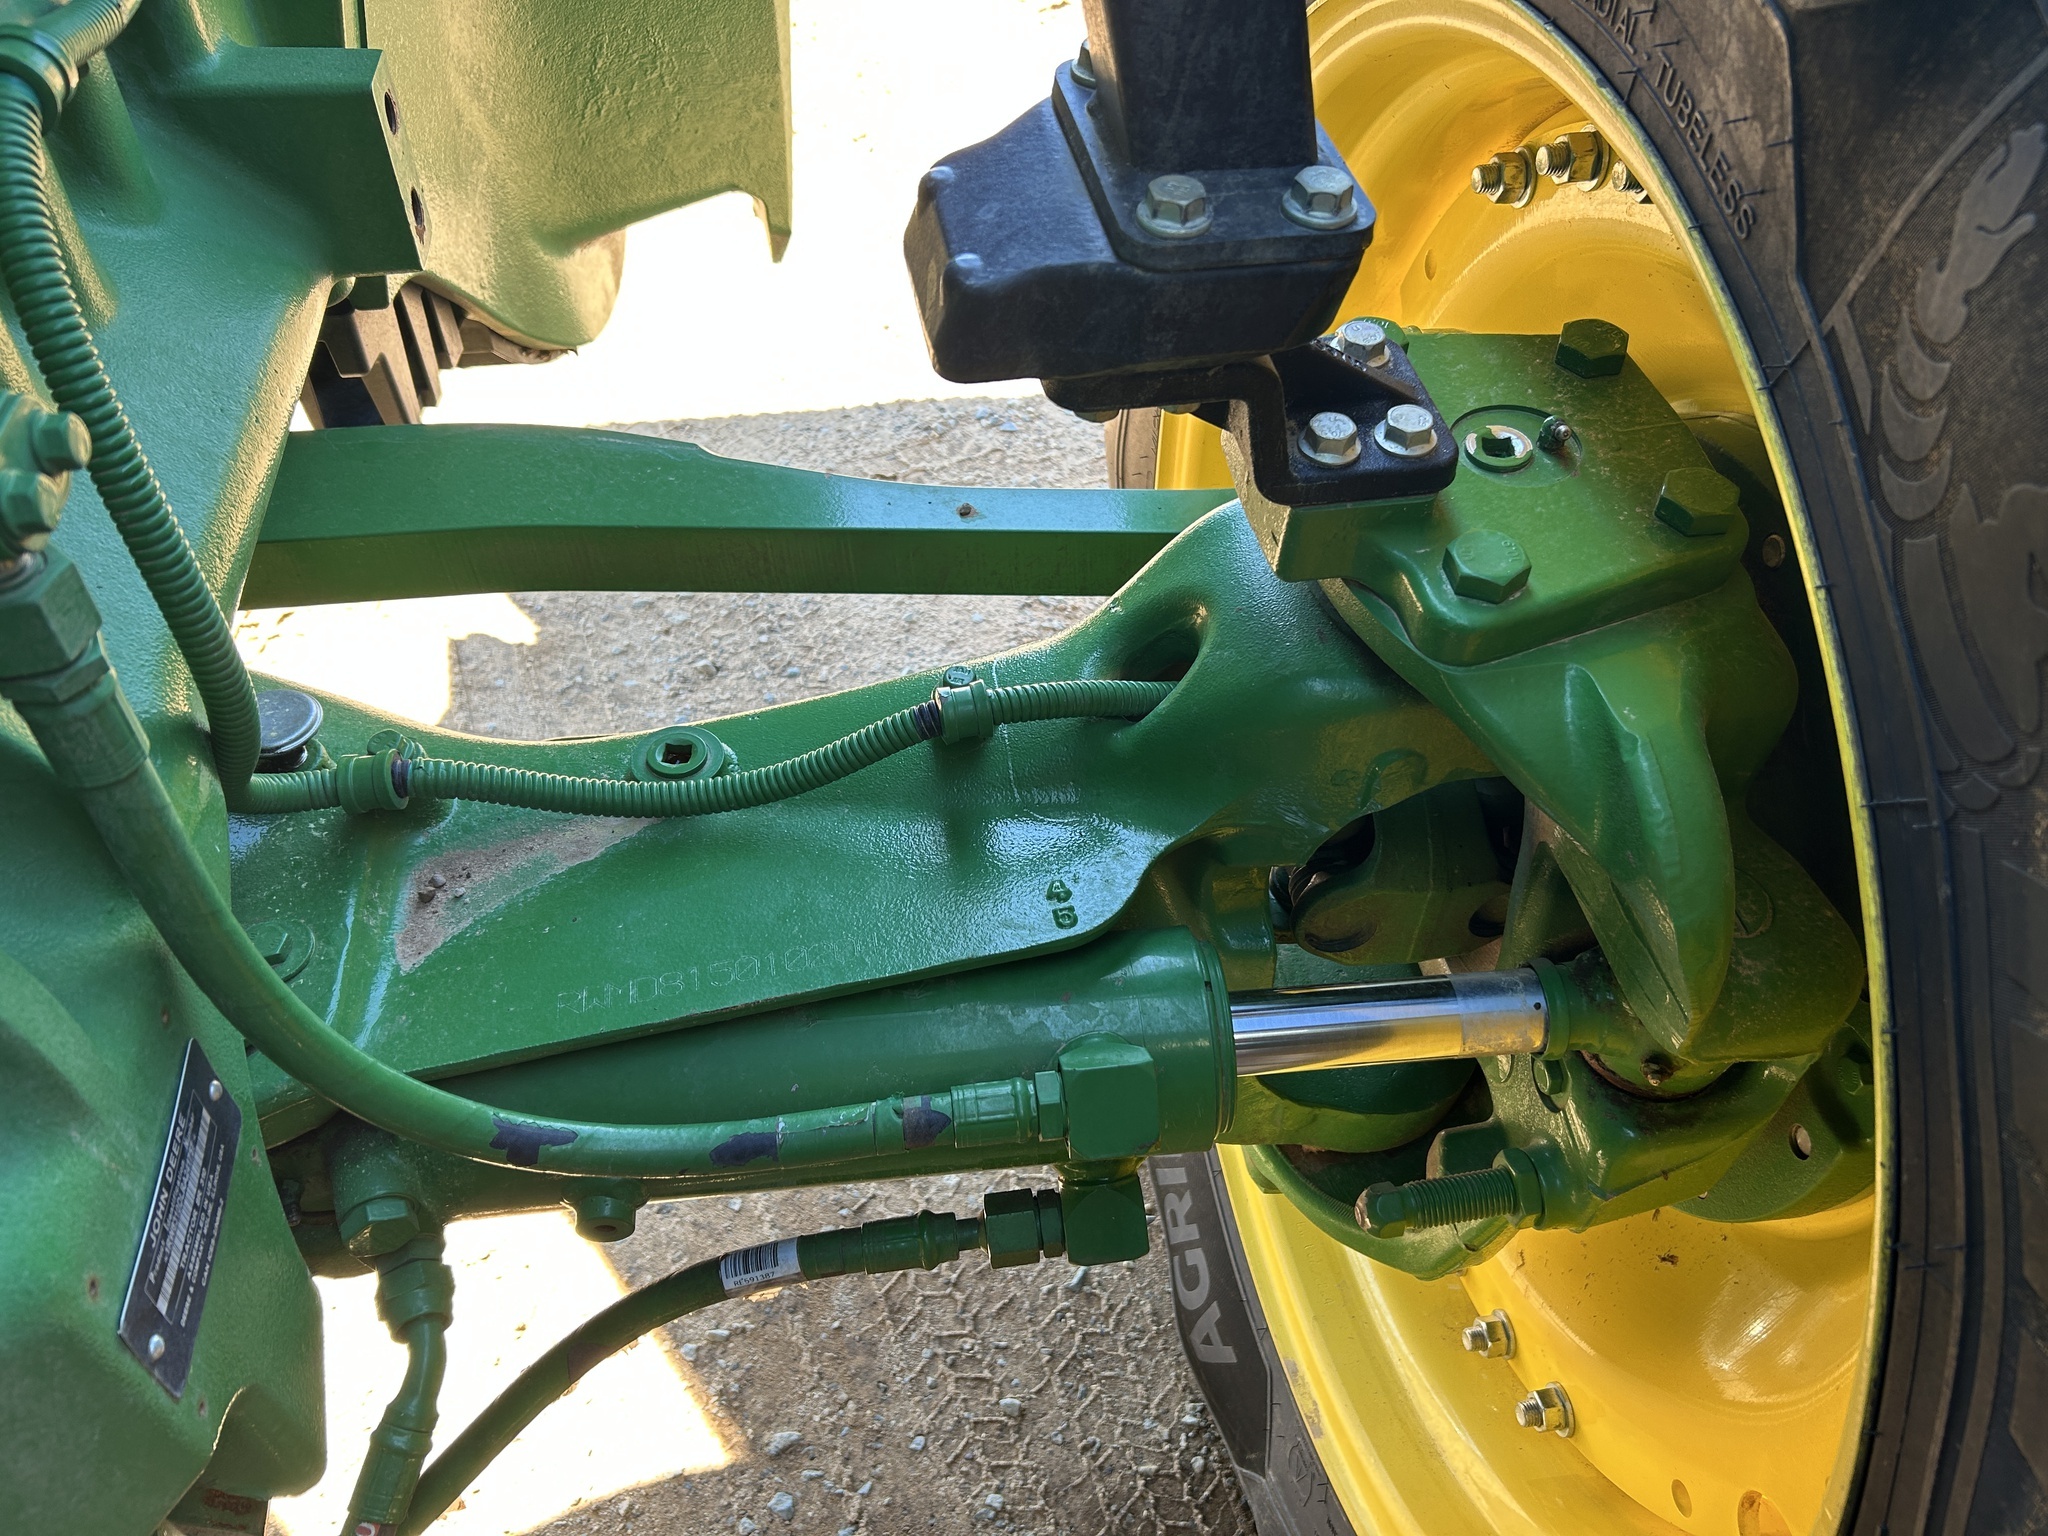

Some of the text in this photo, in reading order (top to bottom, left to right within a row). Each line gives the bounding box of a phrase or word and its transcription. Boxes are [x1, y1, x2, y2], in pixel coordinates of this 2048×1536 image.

[1584, 0, 1756, 240] DIAL TUBELESS
[150, 1113, 186, 1248] JOHN DEERE
[181, 1208, 198, 1269] TRACTOR
[187, 1212, 205, 1281] ASSEMBLED
[1155, 1155, 1239, 1364] AGRI
[202, 1263, 210, 1286] CAN
[181, 1294, 191, 1327] DEERE
